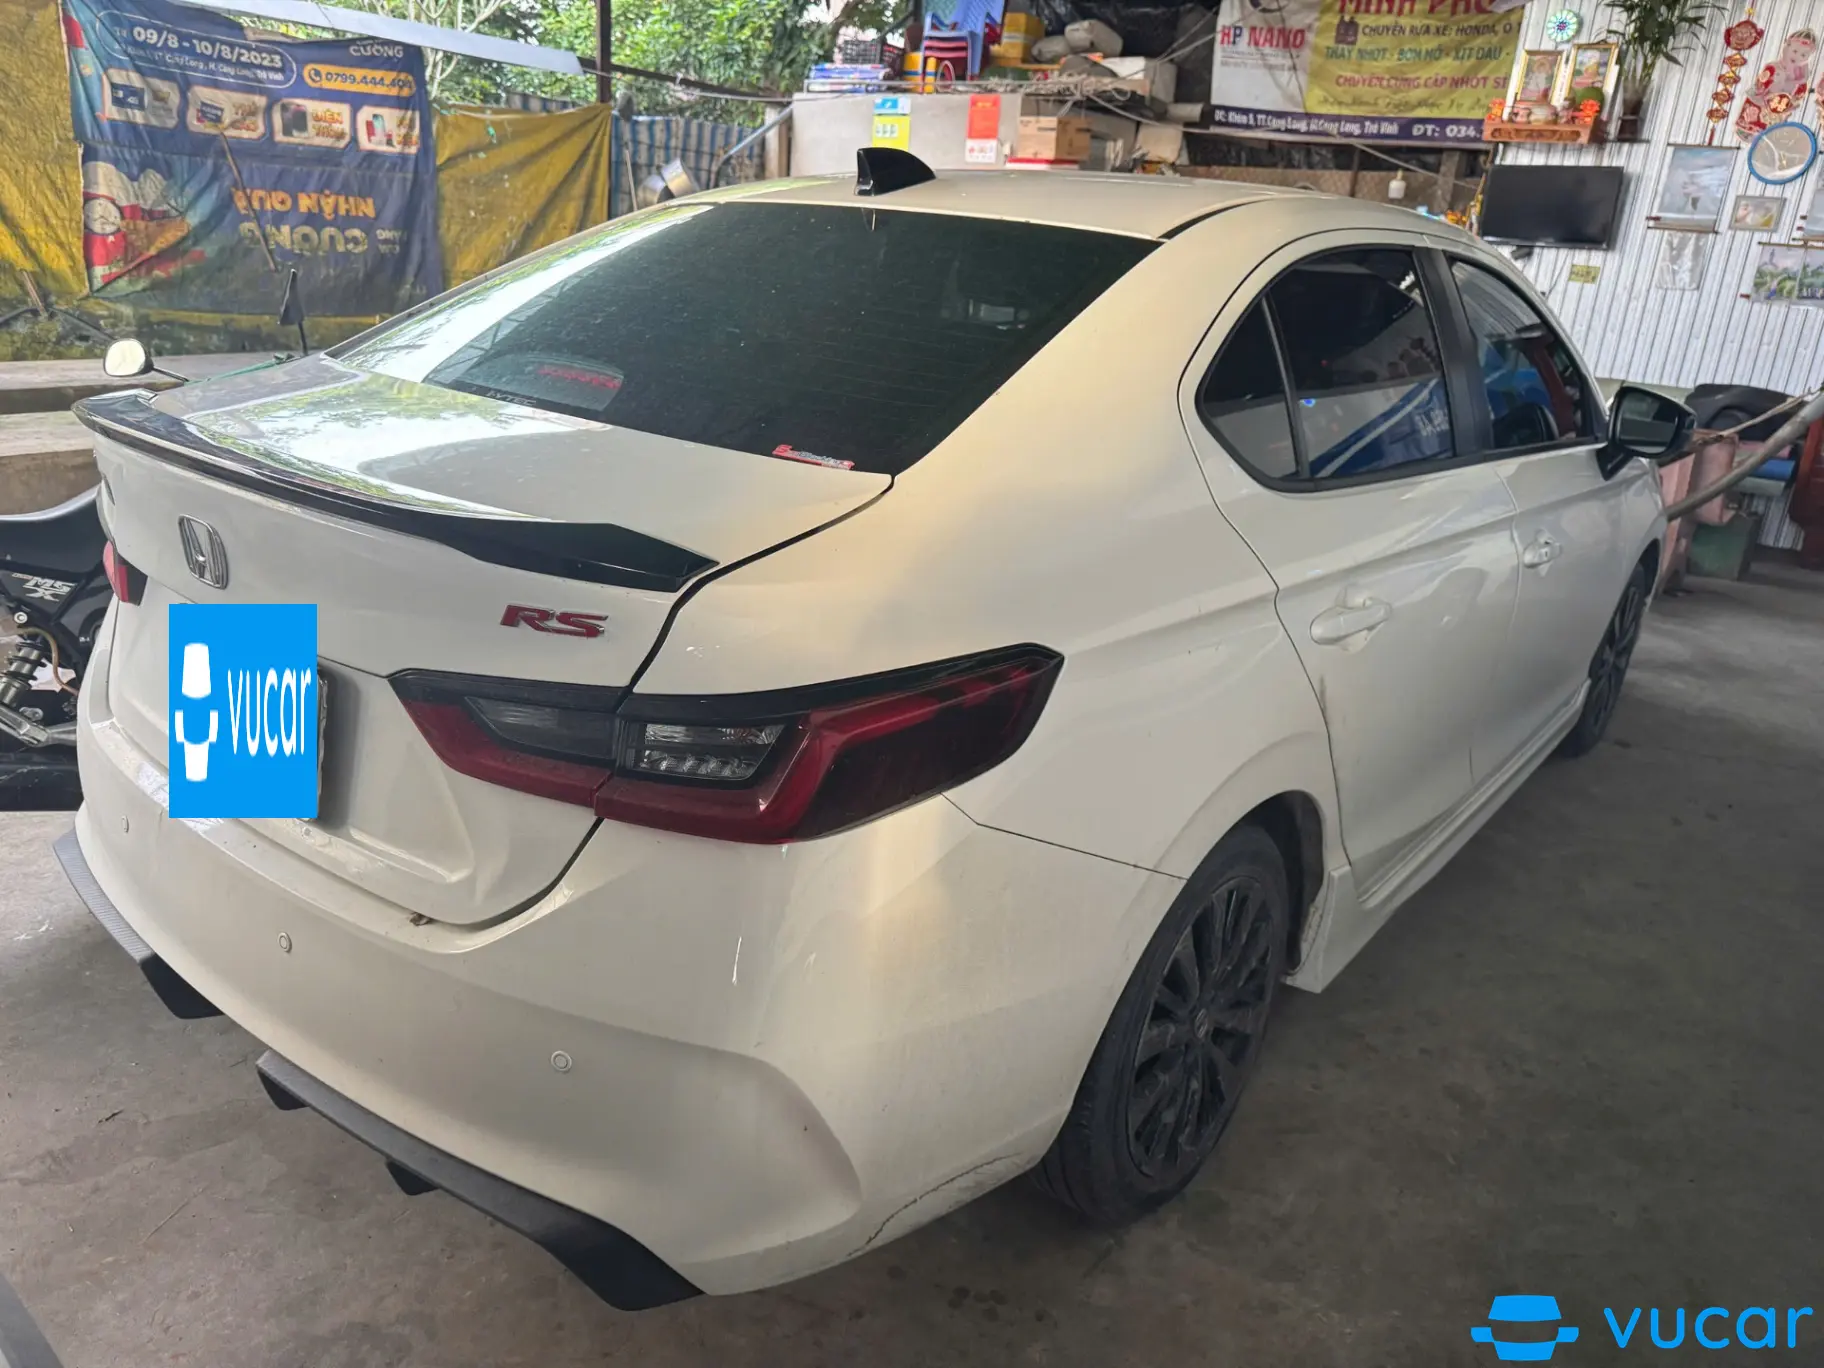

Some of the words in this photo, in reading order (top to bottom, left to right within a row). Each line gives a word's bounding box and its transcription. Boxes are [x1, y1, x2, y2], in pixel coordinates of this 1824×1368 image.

[133, 27, 179, 48] 09/8
[192, 39, 283, 68] 10/8/2023
[1220, 24, 1243, 45] HP
[1248, 25, 1305, 49] NANO
[499, 603, 610, 639] RS
